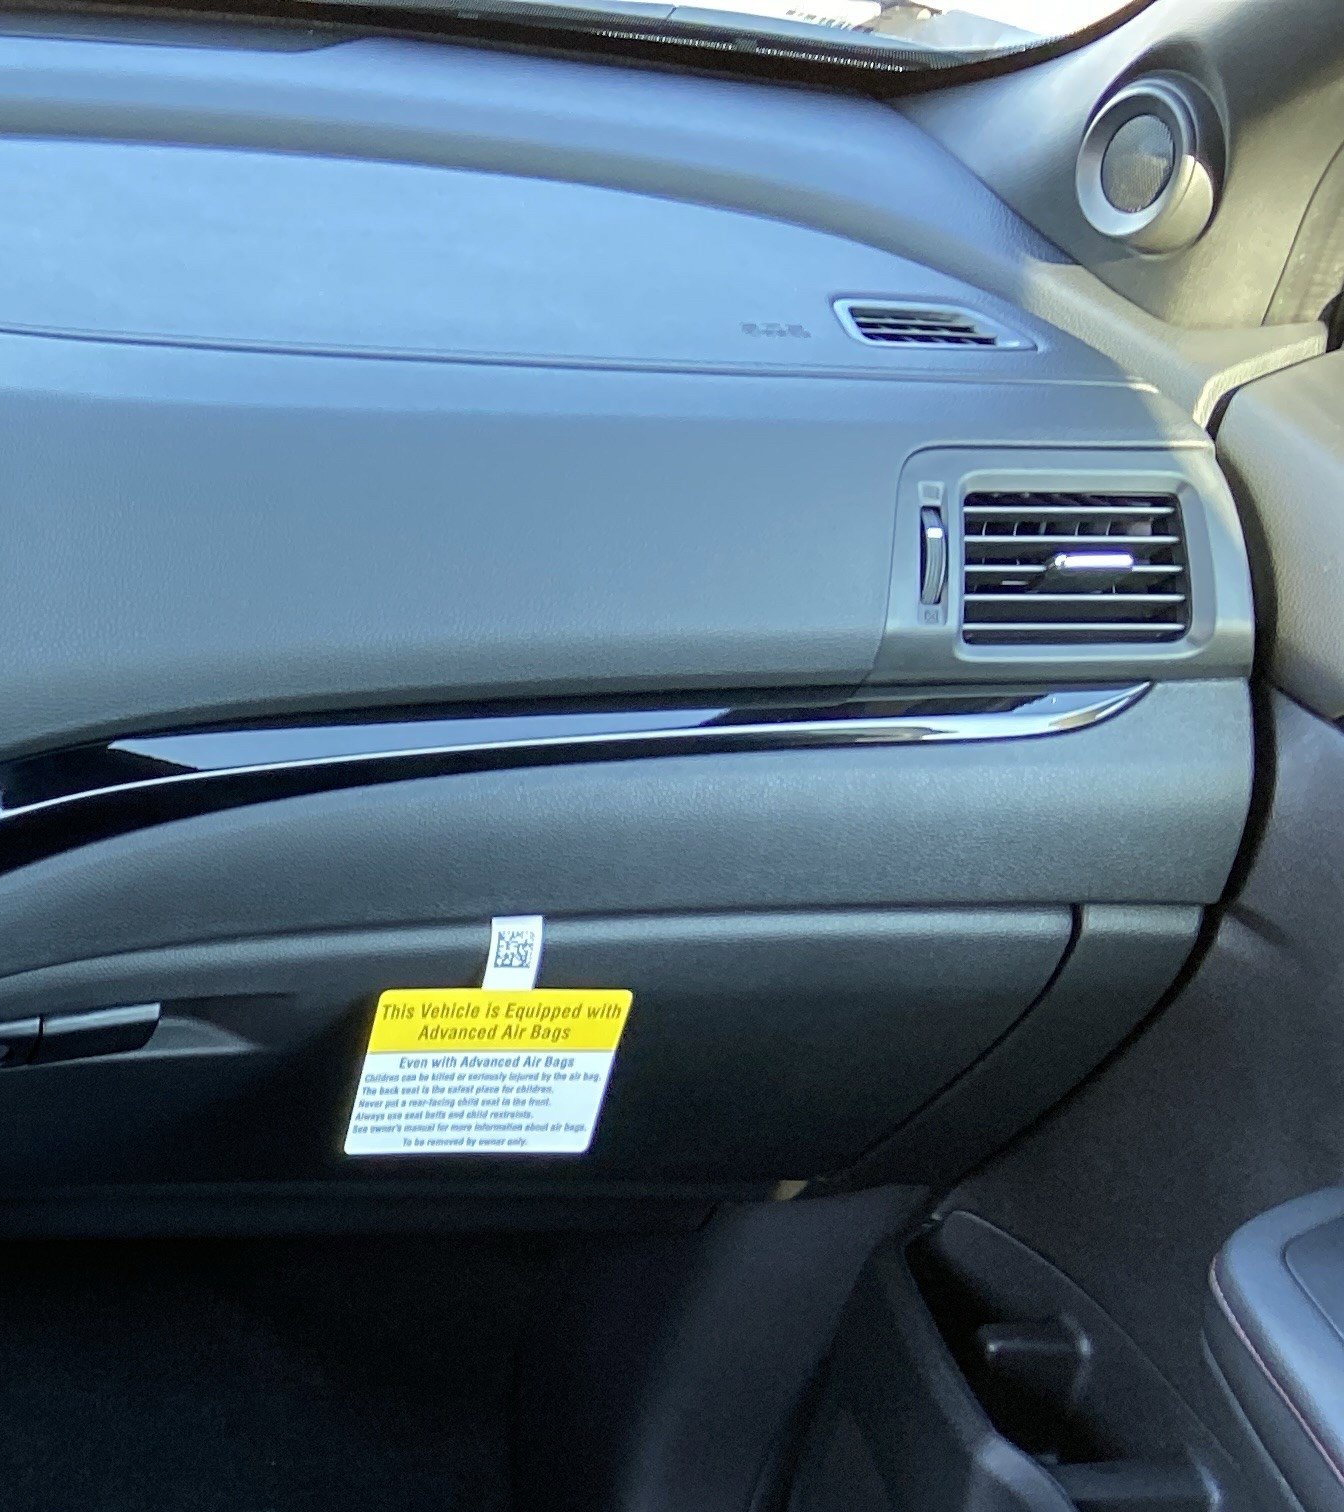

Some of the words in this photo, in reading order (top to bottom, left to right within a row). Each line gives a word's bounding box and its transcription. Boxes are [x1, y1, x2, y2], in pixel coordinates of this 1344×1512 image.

[382, 1003, 415, 1020] This
[421, 1002, 480, 1020] Vehicle
[486, 1001, 500, 1019] is
[504, 1002, 583, 1022] Equipped
[587, 1003, 622, 1019] with
[417, 1024, 498, 1041] Advanced
[501, 1024, 527, 1040] Air
[530, 1024, 572, 1043] Bags
[399, 1057, 428, 1069] Even
[432, 1056, 457, 1068] with
[460, 1056, 520, 1068] Advanced
[523, 1056, 542, 1068] Air
[544, 1056, 575, 1070] Bags
[364, 1073, 400, 1083] Children
[431, 1072, 455, 1082] killed
[468, 1072, 507, 1083] seriously
[508, 1072, 539, 1082] injured
[541, 1072, 552, 1083] by
[553, 1072, 567, 1081] the
[569, 1072, 581, 1081] air
[362, 1086, 377, 1095] The
[432, 1085, 446, 1094] the
[448, 1085, 474, 1094] safest
[475, 1085, 500, 1095] place
[502, 1085, 514, 1094] for
[355, 1111, 385, 1121] Always
[427, 1137, 464, 1146] removed
[466, 1138, 476, 1147] by
